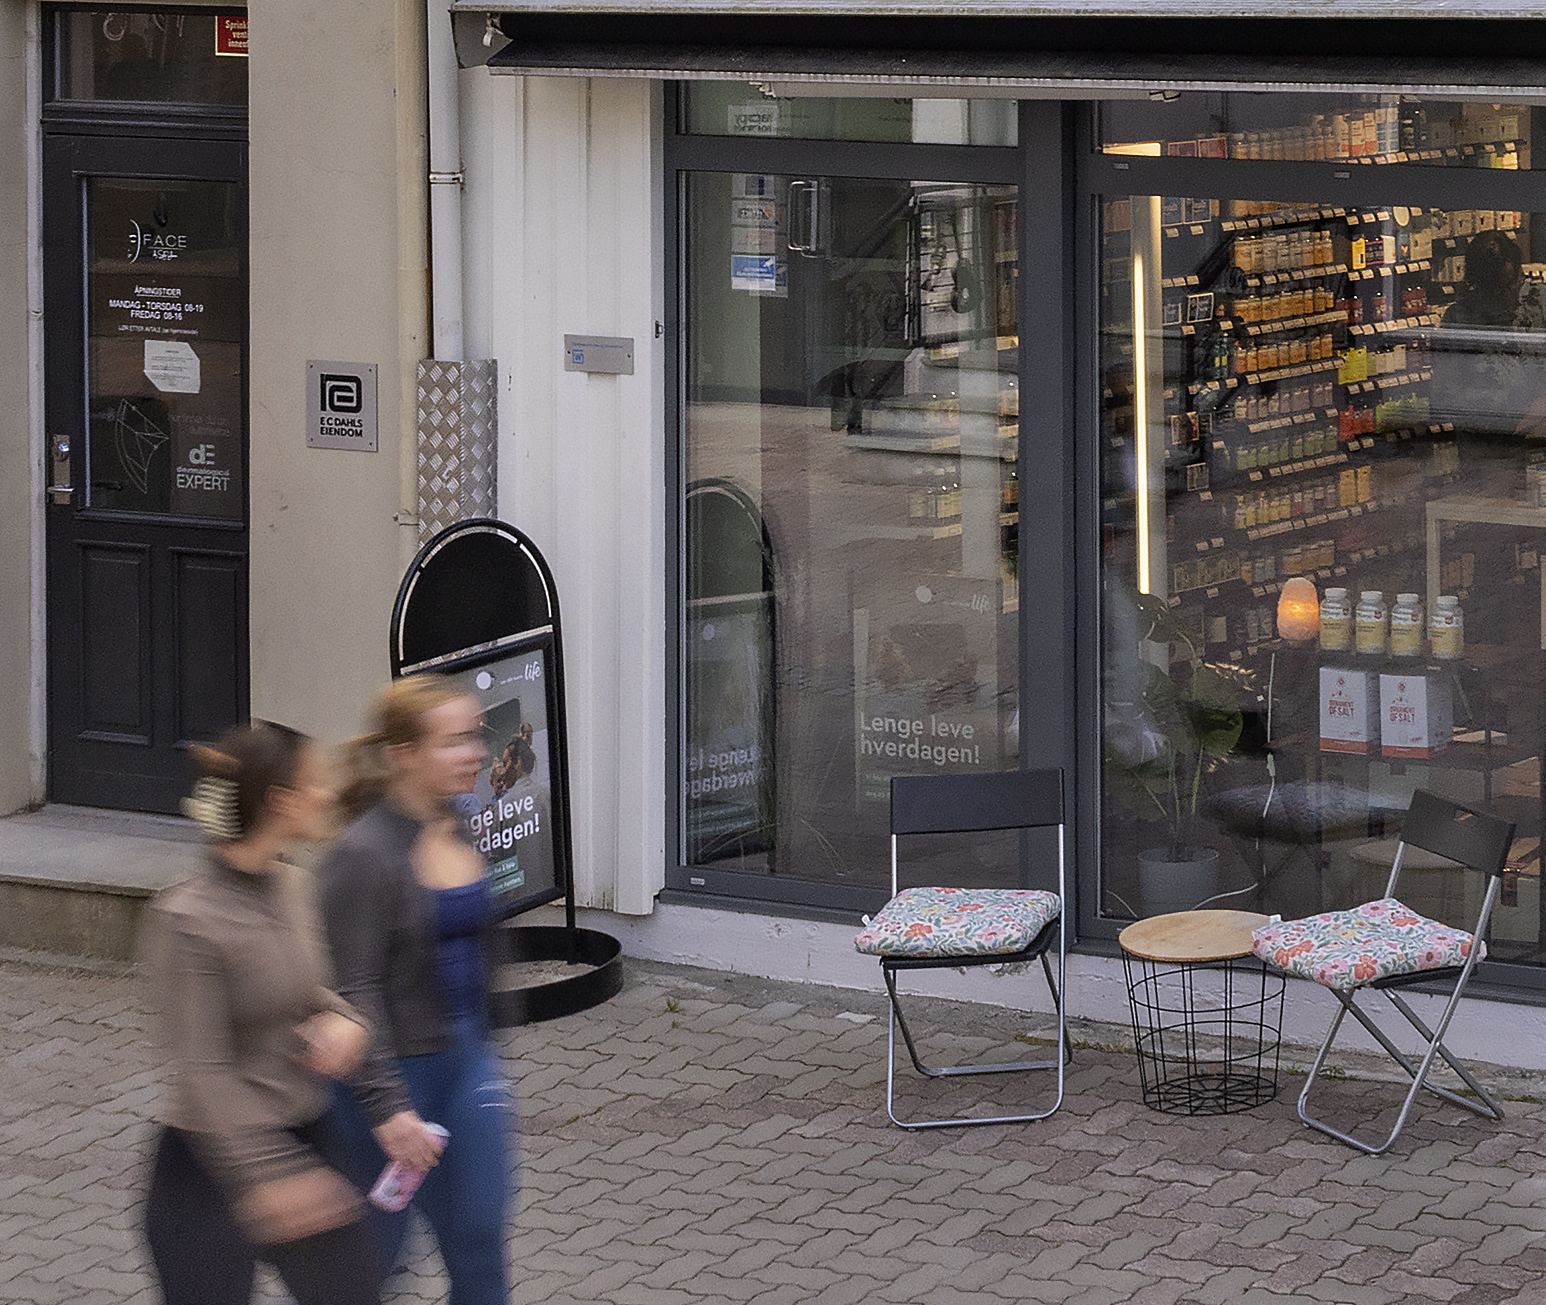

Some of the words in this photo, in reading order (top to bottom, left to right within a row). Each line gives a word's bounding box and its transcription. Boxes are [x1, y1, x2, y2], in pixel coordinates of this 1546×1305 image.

[143, 233, 187, 248] FACE
[108, 299, 141, 309] MANDAG
[146, 301, 182, 312] TORSDAG
[130, 309, 161, 320] FREDAG
[320, 417, 326, 426] E
[326, 417, 334, 427] C
[334, 418, 364, 428] DAHLS
[320, 426, 364, 438] EIENDOM
[177, 474, 230, 492] EXPERT
[524, 660, 542, 682] life
[859, 712, 924, 739] Lenge
[931, 714, 975, 739] leve
[859, 732, 981, 766] hverdagen!
[498, 795, 534, 822] leve
